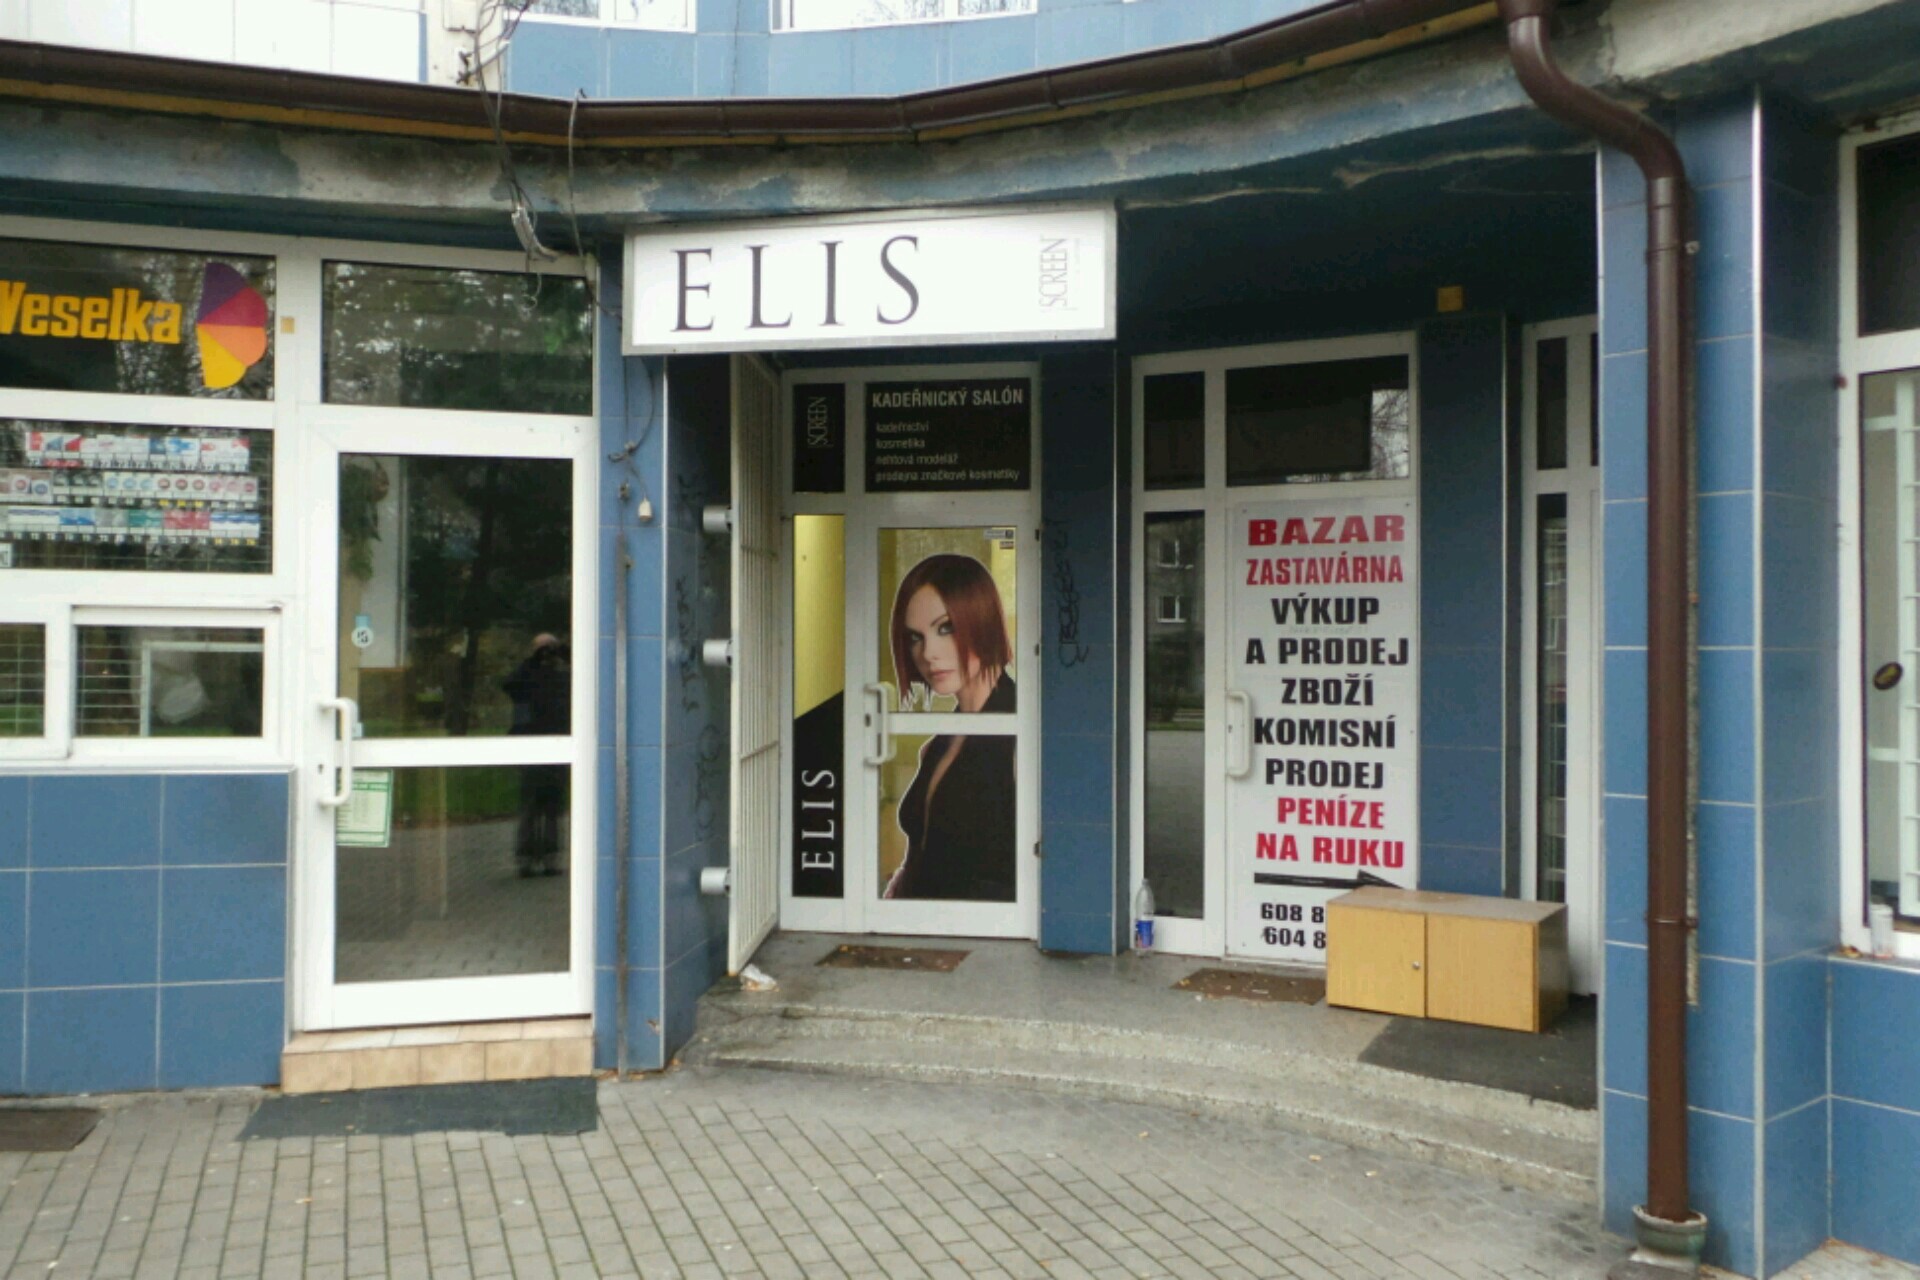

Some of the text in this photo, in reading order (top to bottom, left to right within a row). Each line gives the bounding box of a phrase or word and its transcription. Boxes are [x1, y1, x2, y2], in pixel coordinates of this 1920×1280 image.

[671, 235, 920, 332] ELIS
[1039, 238, 1067, 307] SCREEN
[872, 385, 1024, 407] KADEŘNICKÝ SALÓN
[807, 397, 828, 446] SCREEN
[875, 437, 926, 449] kosmetika
[875, 470, 919, 483] prodejna
[1248, 515, 1405, 546] BAZAR
[1246, 551, 1403, 585] ZASTAVÁRNA
[1271, 592, 1380, 625] VÝKUP
[1245, 638, 1409, 665] A PRODEJ
[1281, 673, 1374, 706] ZBOŽÍ
[1254, 715, 1396, 749] KOMISNÍ
[1265, 758, 1384, 789] PRODEJ
[801, 770, 835, 871] ELIS
[1278, 794, 1384, 829] PENÍZE
[1256, 832, 1404, 869] NA RUKU
[1261, 902, 1303, 922] 608
[1263, 926, 1306, 947] 604
